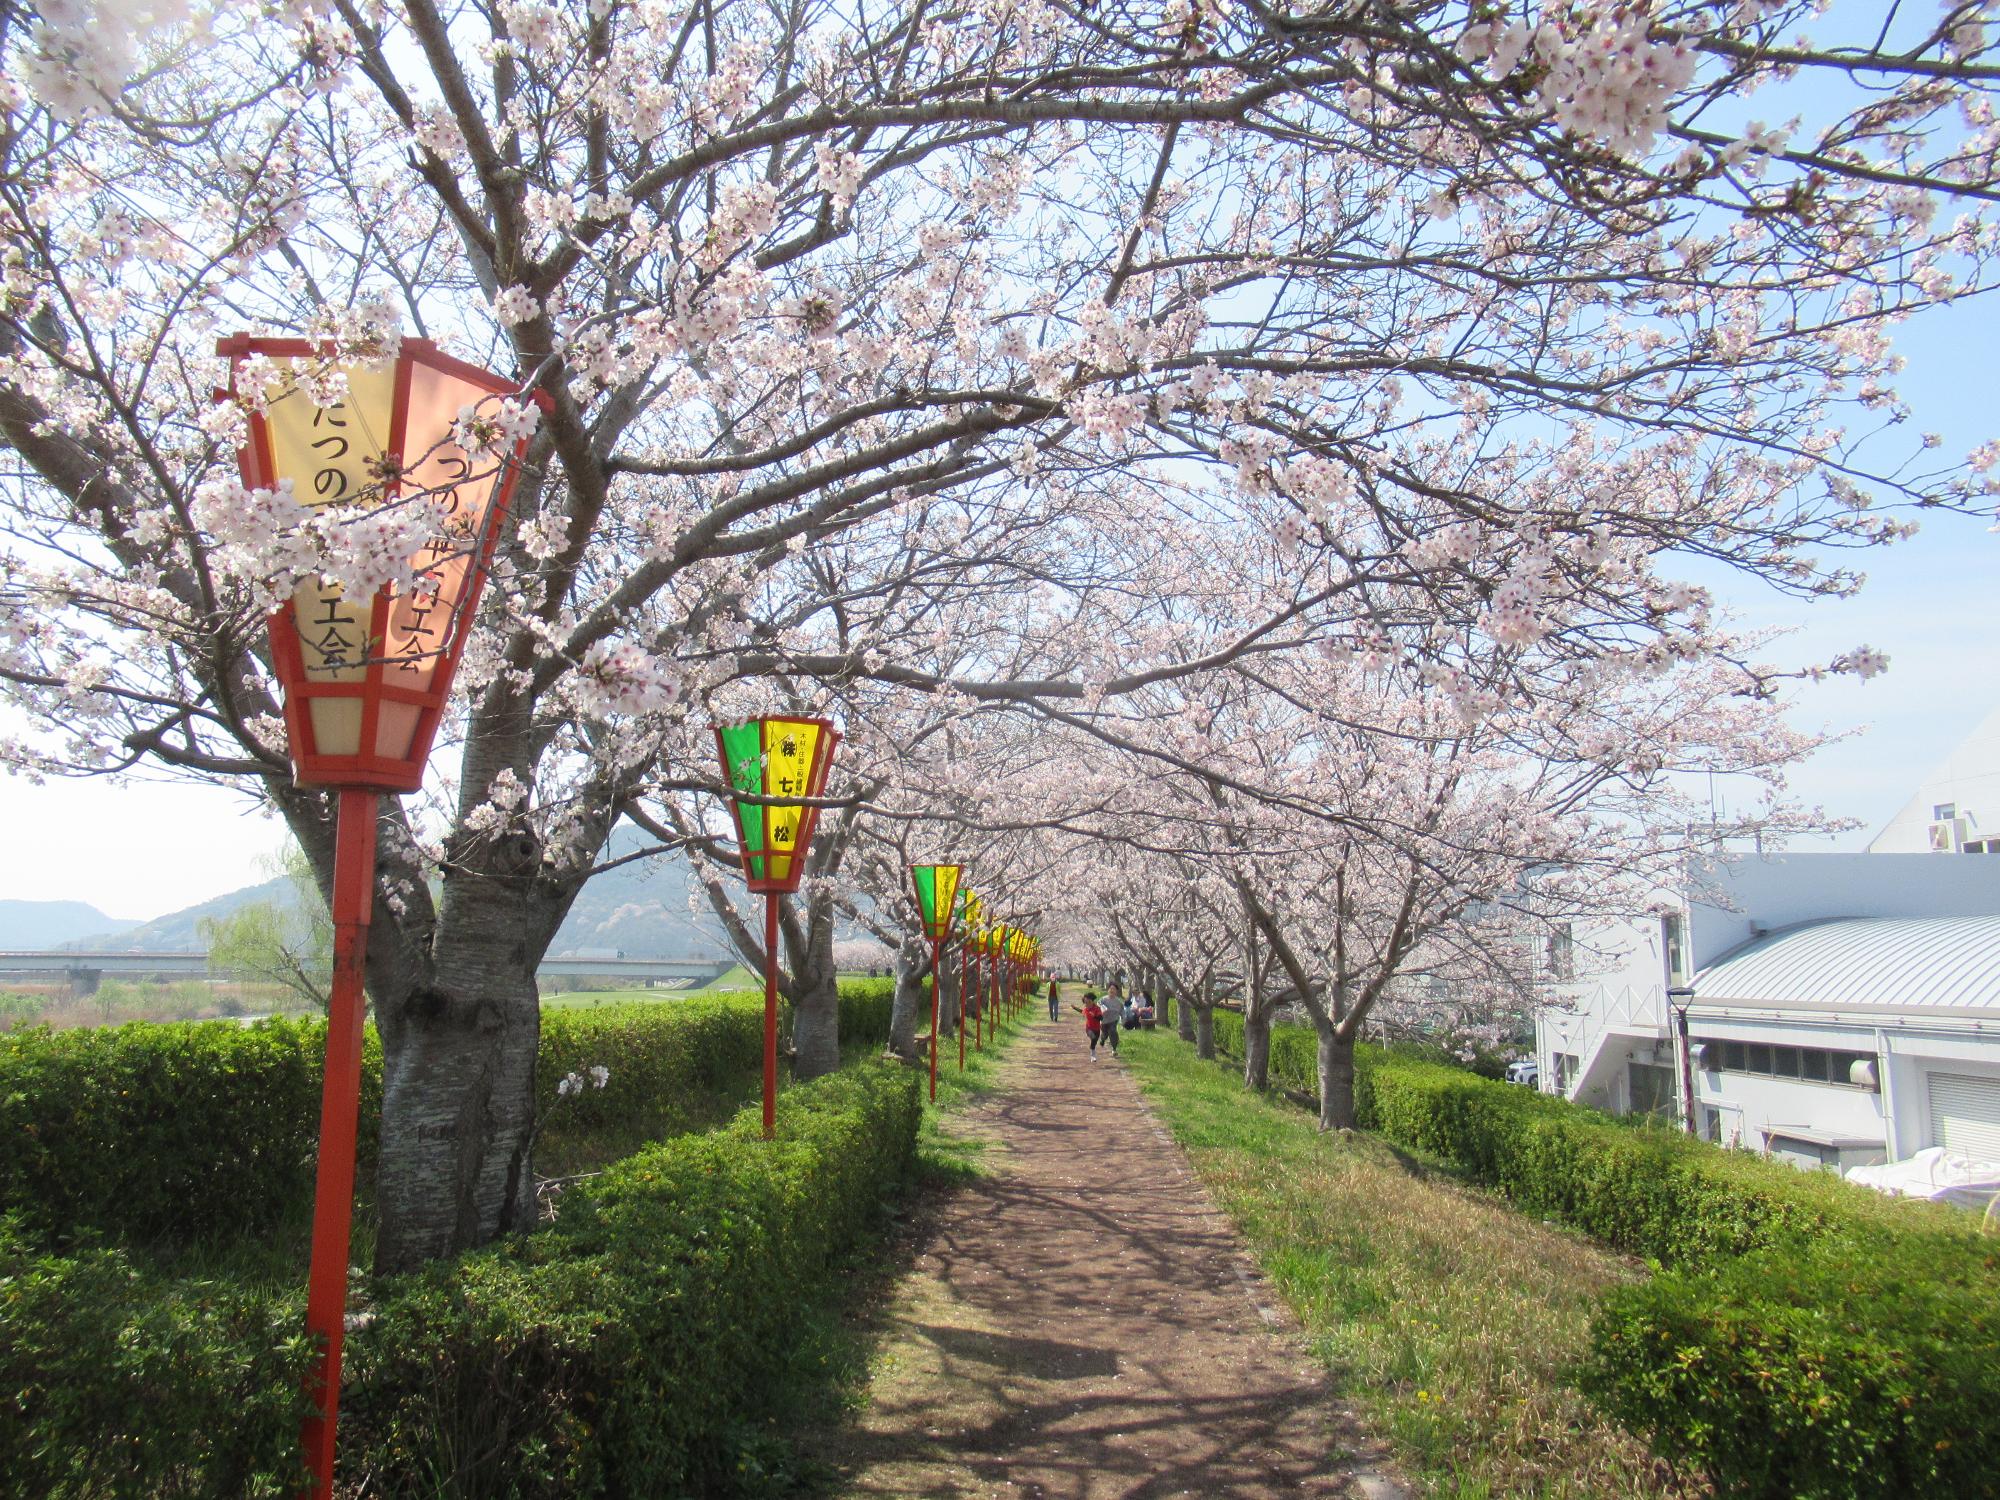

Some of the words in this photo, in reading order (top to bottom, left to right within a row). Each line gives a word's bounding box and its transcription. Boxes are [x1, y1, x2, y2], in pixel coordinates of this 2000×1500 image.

[311, 402, 356, 678] たつの工会
